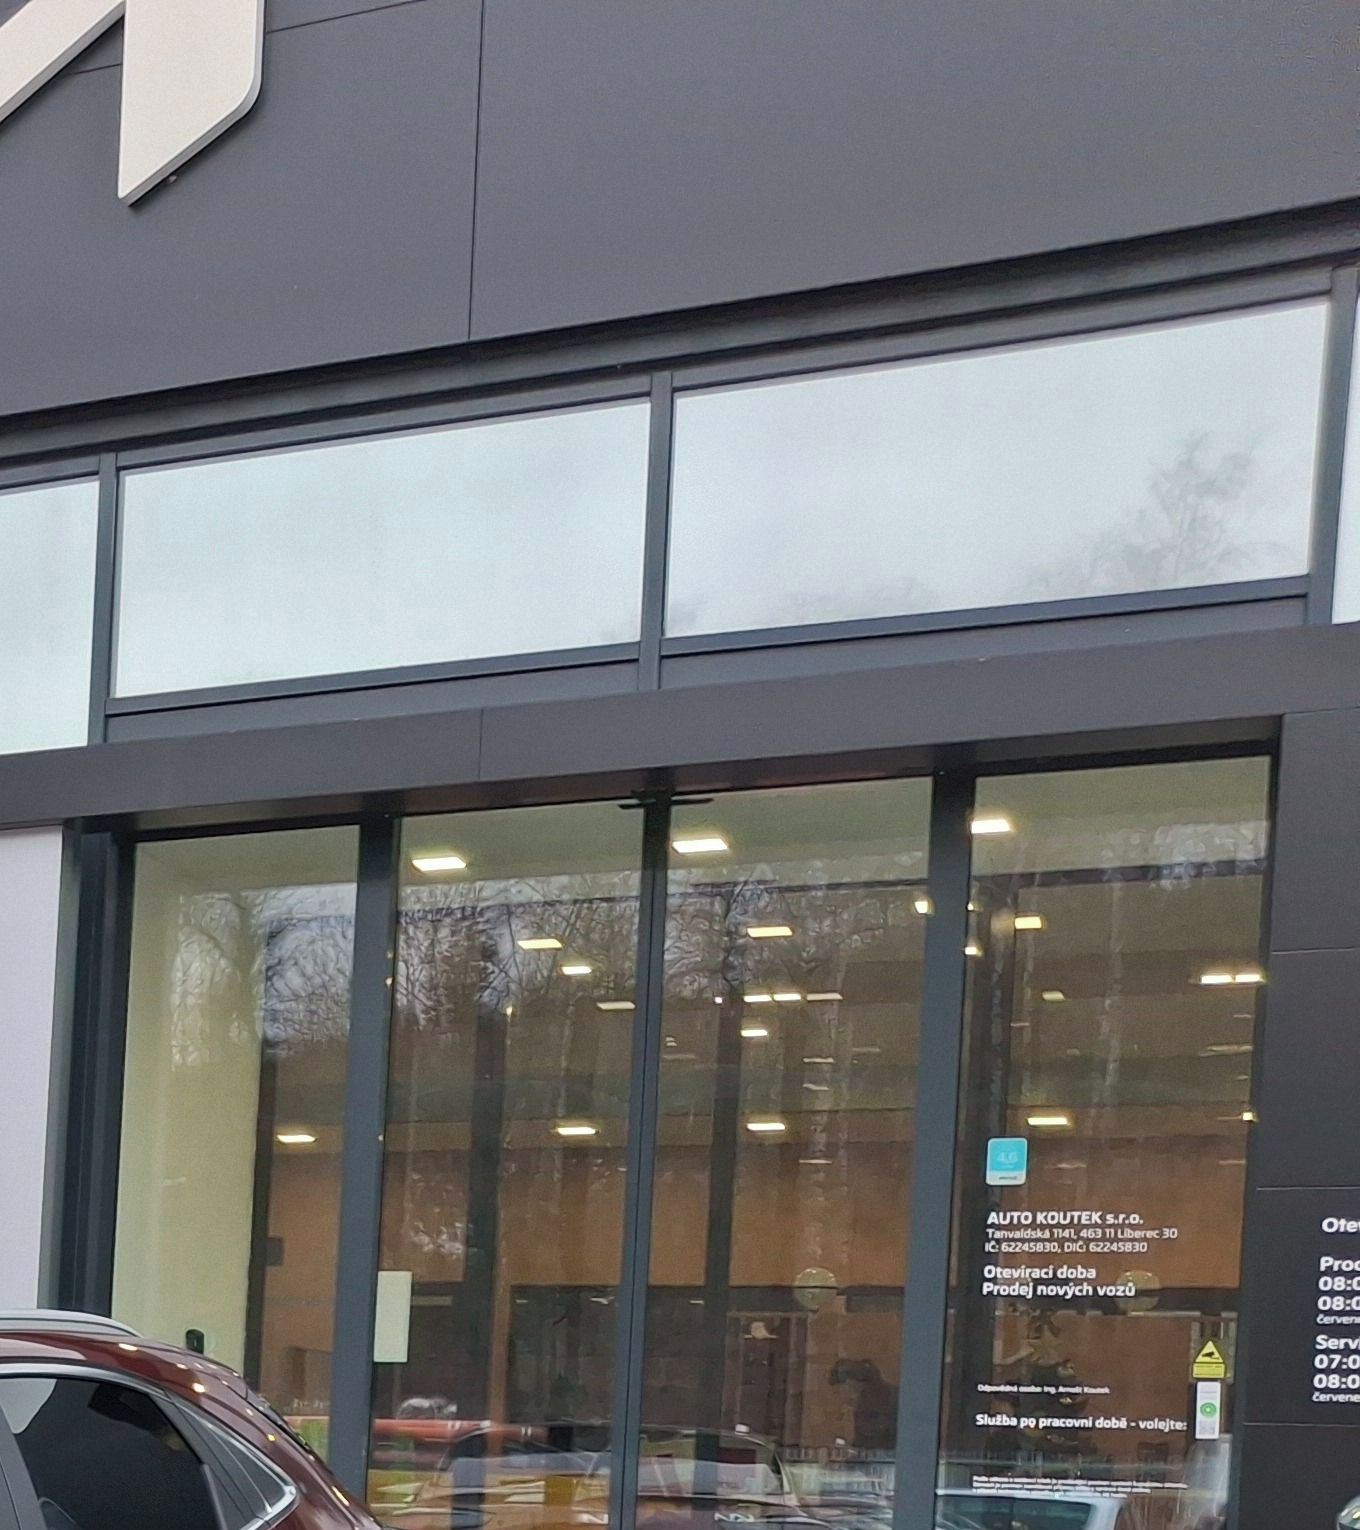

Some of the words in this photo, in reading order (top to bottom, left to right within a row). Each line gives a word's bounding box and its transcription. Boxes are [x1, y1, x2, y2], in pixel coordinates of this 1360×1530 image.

[986, 1211, 1033, 1225] AUTO
[1036, 1211, 1103, 1225] KOUTEK
[1105, 1212, 1144, 1225] s.r.o.
[1321, 1216, 1360, 1233] Ote
[985, 1228, 1051, 1239] Tanvaldská
[1080, 1229, 1102, 1239] 463
[1105, 1229, 1115, 1239] 11
[1117, 1228, 1160, 1239] Liberec
[1161, 1228, 1178, 1239] 30
[1088, 1242, 1148, 1253] 62245830
[1056, 1264, 1097, 1279] doba
[982, 1282, 1033, 1299] Prodej
[1036, 1282, 1093, 1299] nových
[1096, 1282, 1136, 1297] vozů
[1314, 1353, 1360, 1370] 07:0
[1313, 1373, 1360, 1389] 08:0
[975, 1413, 1018, 1426] Služba
[1020, 1417, 1037, 1429] po
[1038, 1416, 1093, 1429] pracovní
[1095, 1416, 1128, 1429] době
[1138, 1417, 1188, 1432] volejte:
